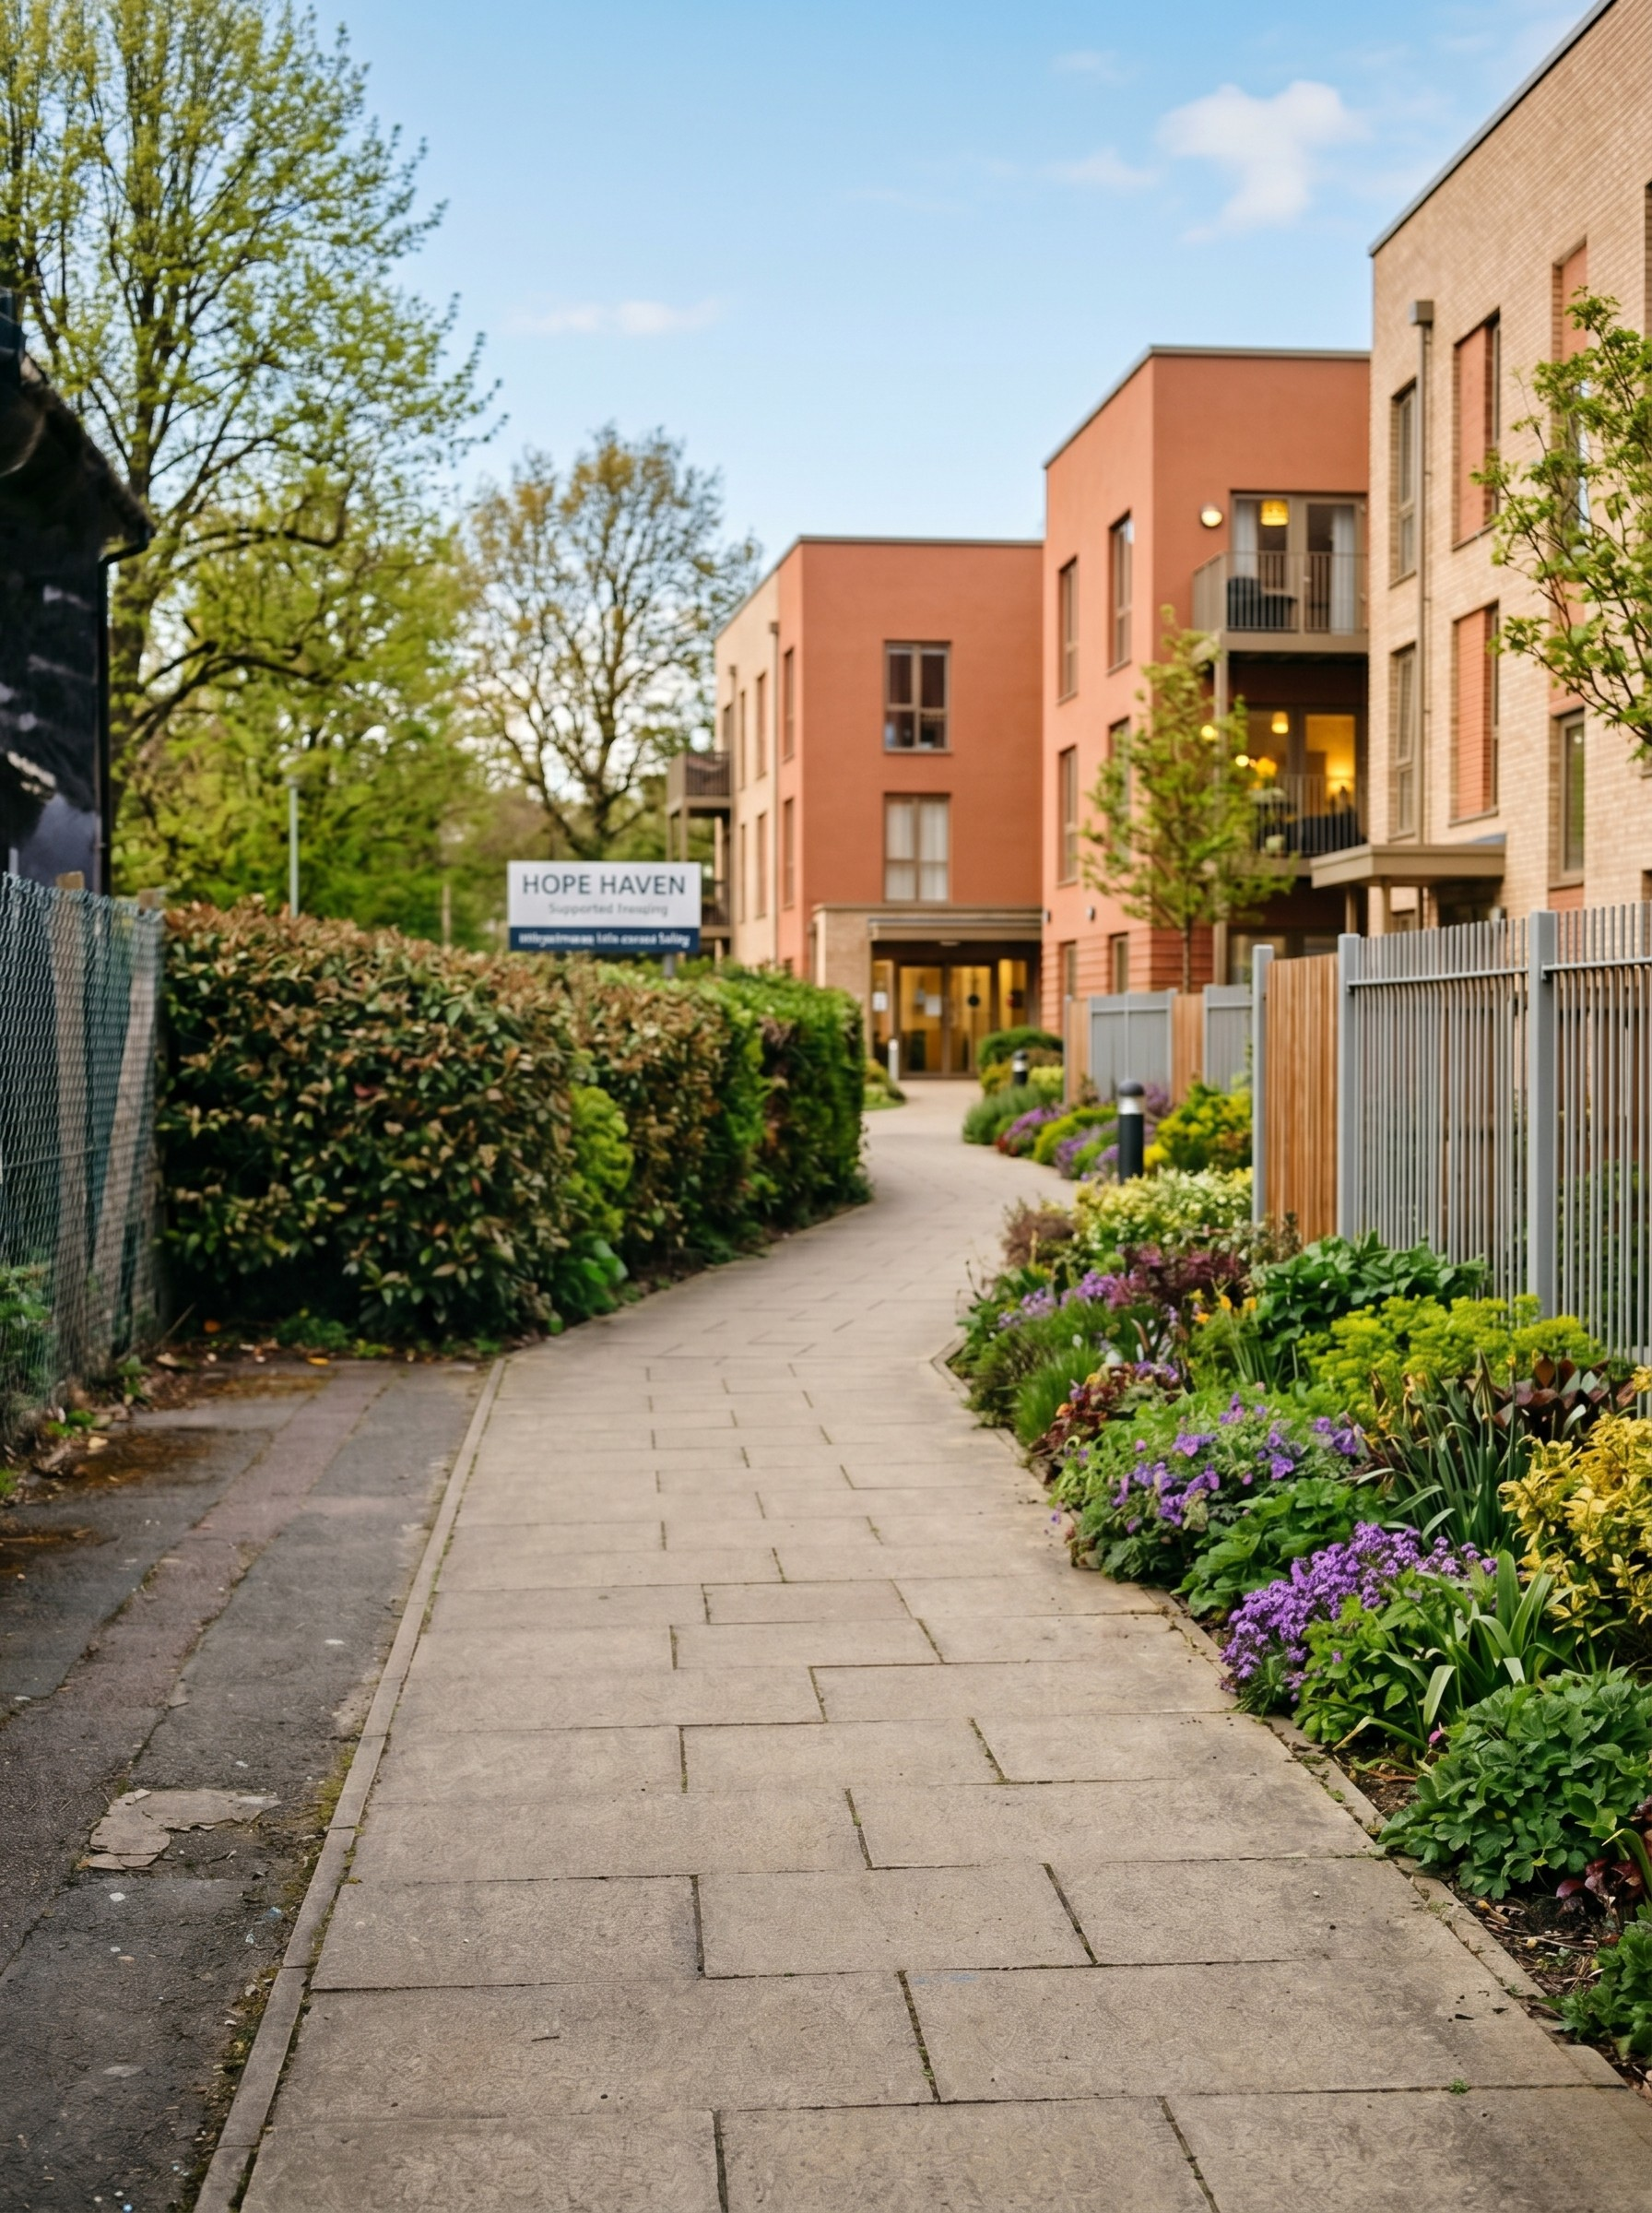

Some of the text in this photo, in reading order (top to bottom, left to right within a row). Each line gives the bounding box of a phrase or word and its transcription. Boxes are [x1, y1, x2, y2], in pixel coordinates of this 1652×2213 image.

[523, 875, 685, 894] HOPE HAVEN
[549, 903, 613, 916] Supported
